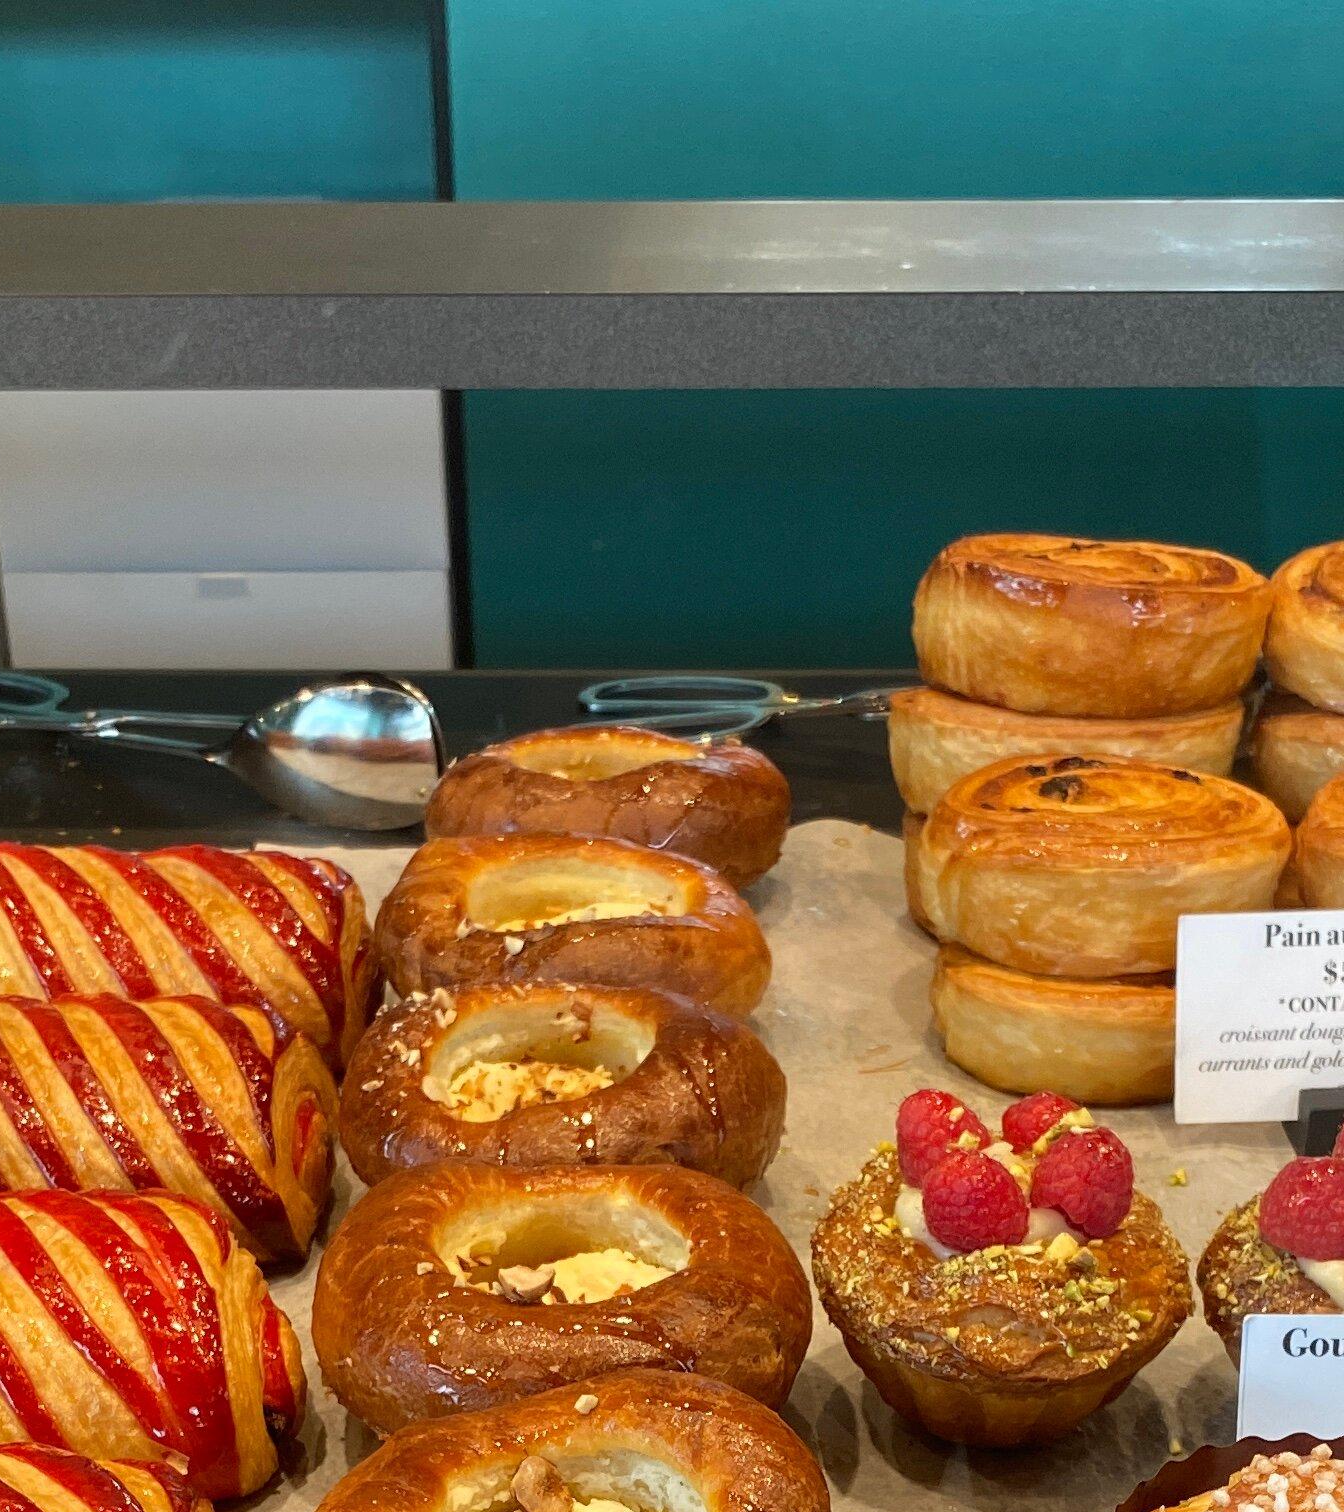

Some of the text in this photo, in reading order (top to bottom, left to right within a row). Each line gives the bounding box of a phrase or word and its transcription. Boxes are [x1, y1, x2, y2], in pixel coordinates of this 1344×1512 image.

[1264, 921, 1320, 948] Pain
[1219, 1024, 1297, 1044] croissant
[1199, 1057, 1269, 1074] currants
[1273, 1053, 1308, 1071] and
